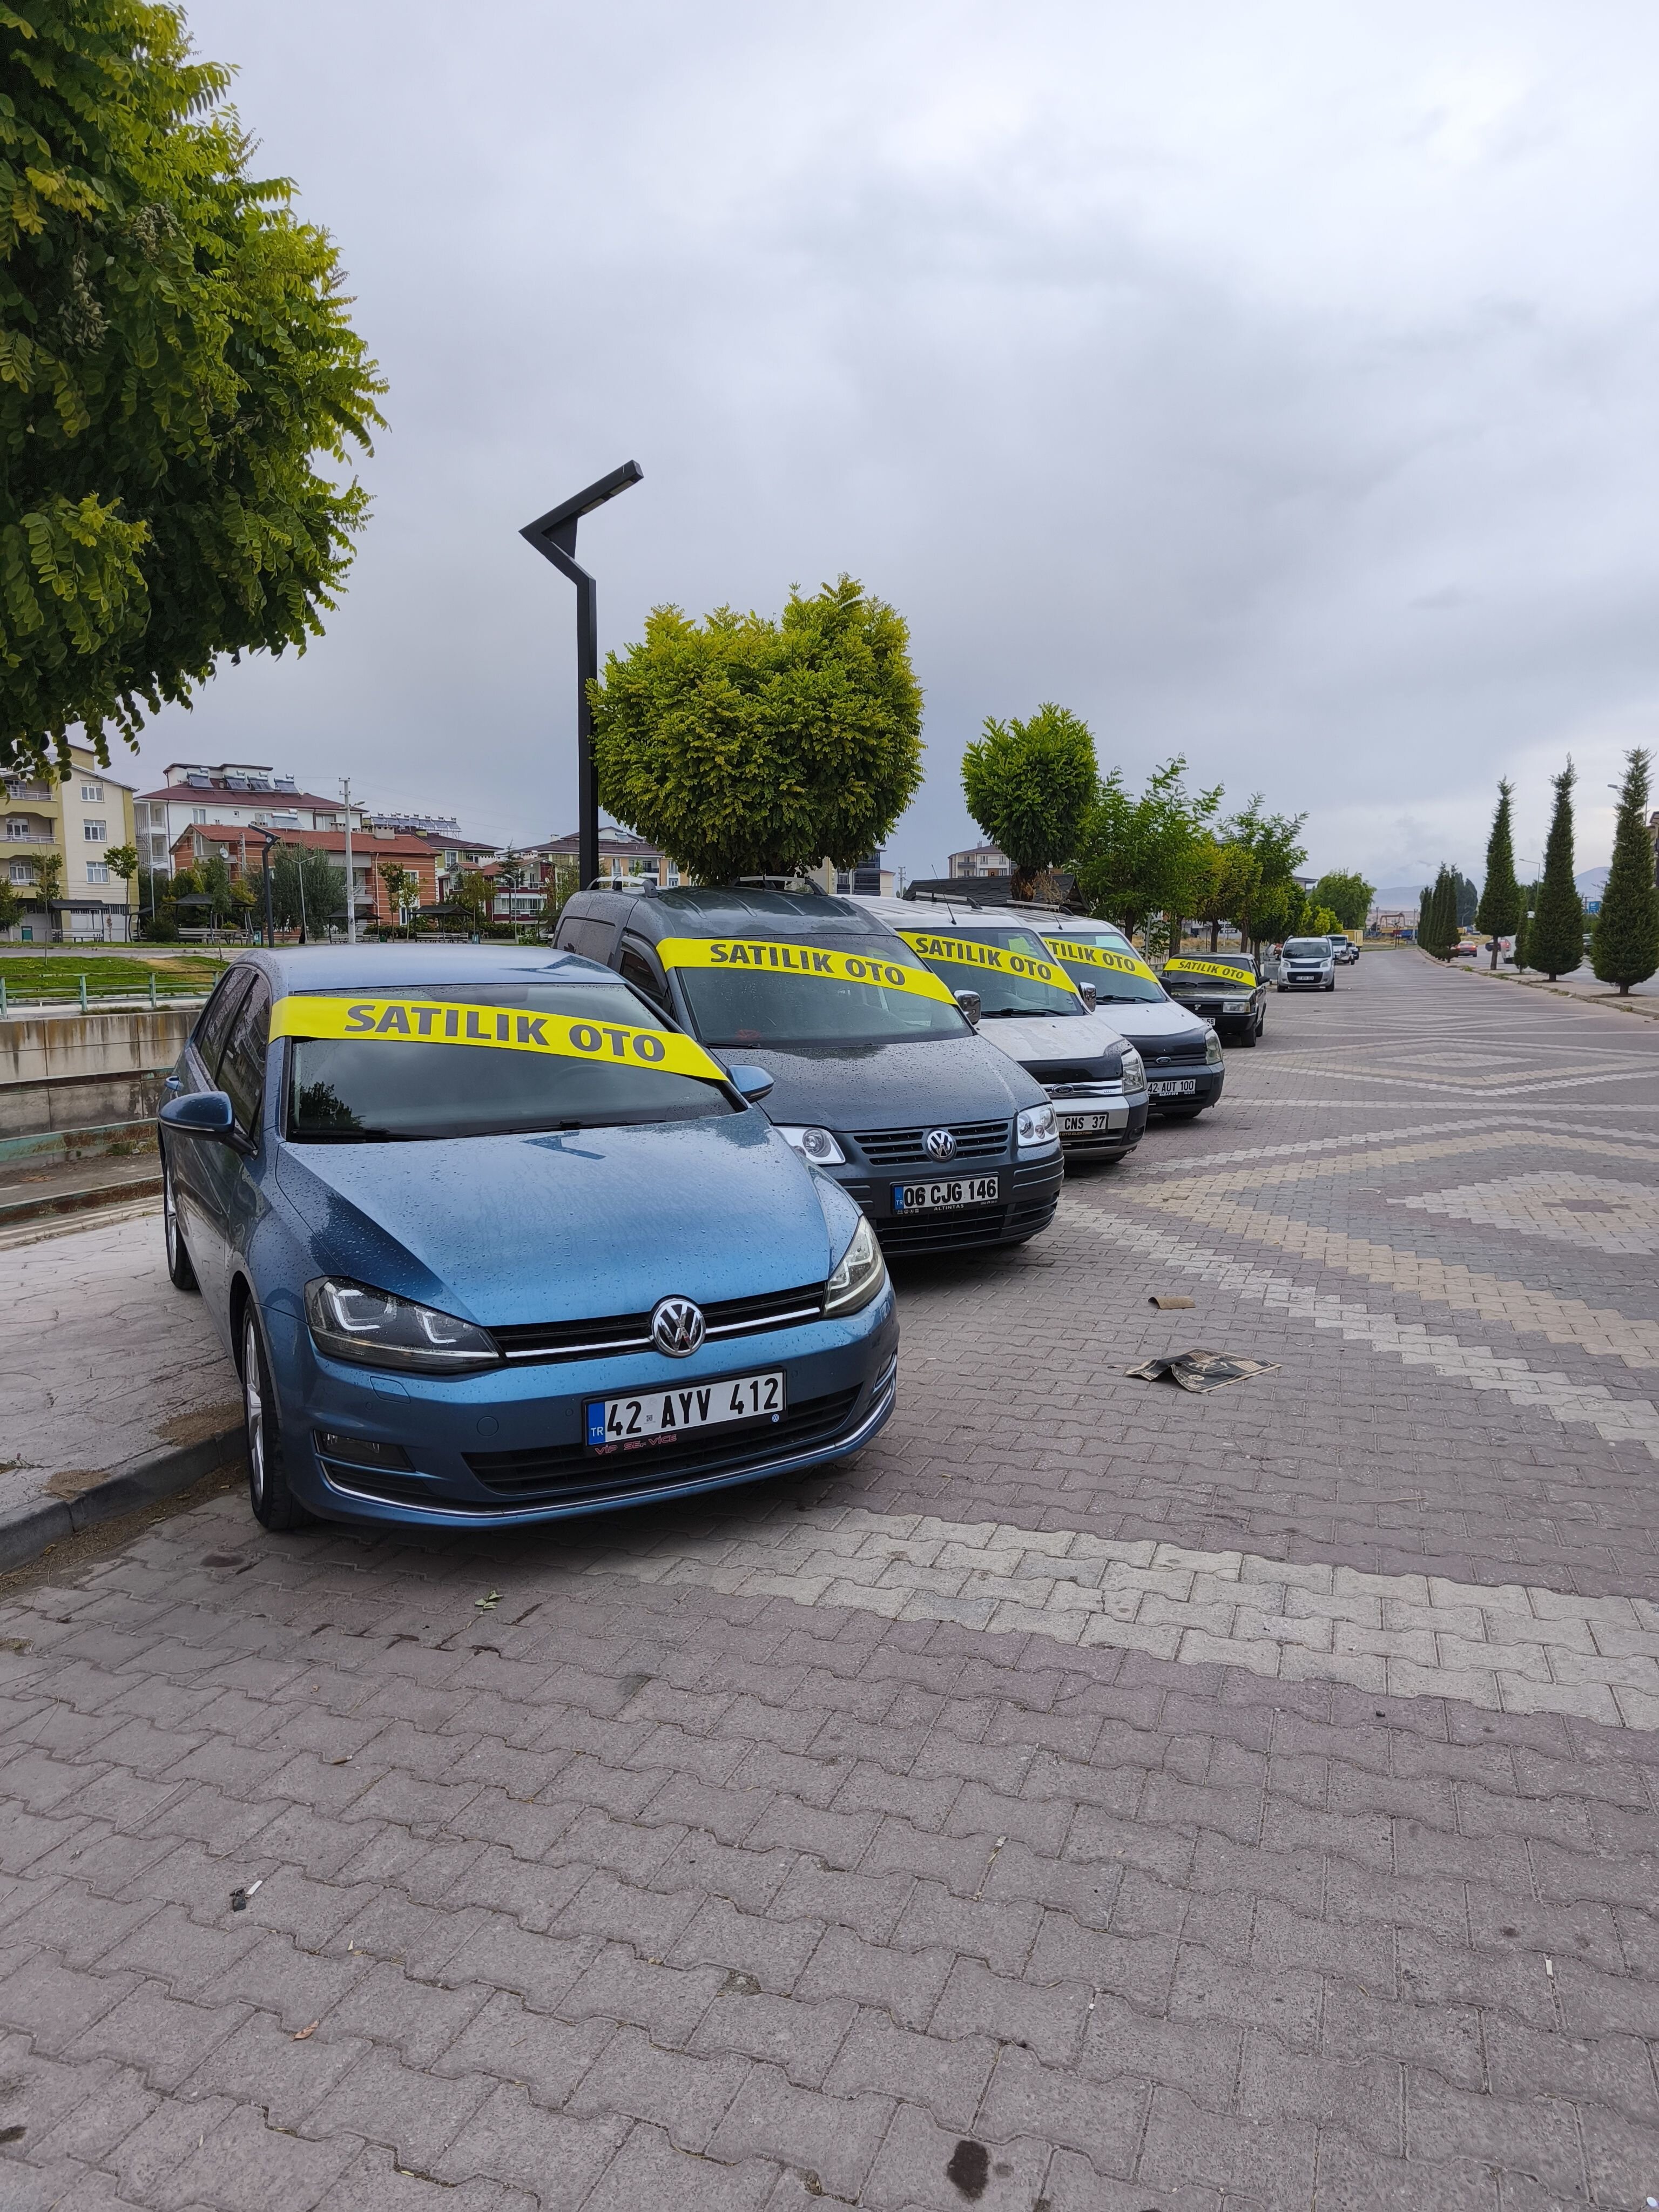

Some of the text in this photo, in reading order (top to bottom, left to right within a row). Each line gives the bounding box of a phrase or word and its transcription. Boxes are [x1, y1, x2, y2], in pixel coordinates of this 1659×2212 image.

[710, 943, 905, 986] SATILIK OTO
[916, 938, 1002, 967] SATILIK
[1010, 956, 1051, 980] OTO
[1044, 941, 1097, 962] TILIK
[1102, 953, 1135, 972] OTO
[1178, 961, 1244, 979] SATILIK OTO
[345, 1004, 665, 1062] SATILIK OTO
[1147, 1080, 1194, 1093] 42 AUT 100
[1064, 1116, 1105, 1130] CNS 37
[903, 1179, 996, 1207] 06 CJG 146
[607, 1378, 778, 1436] 42 AYV 412
[590, 1426, 604, 1437] TR
